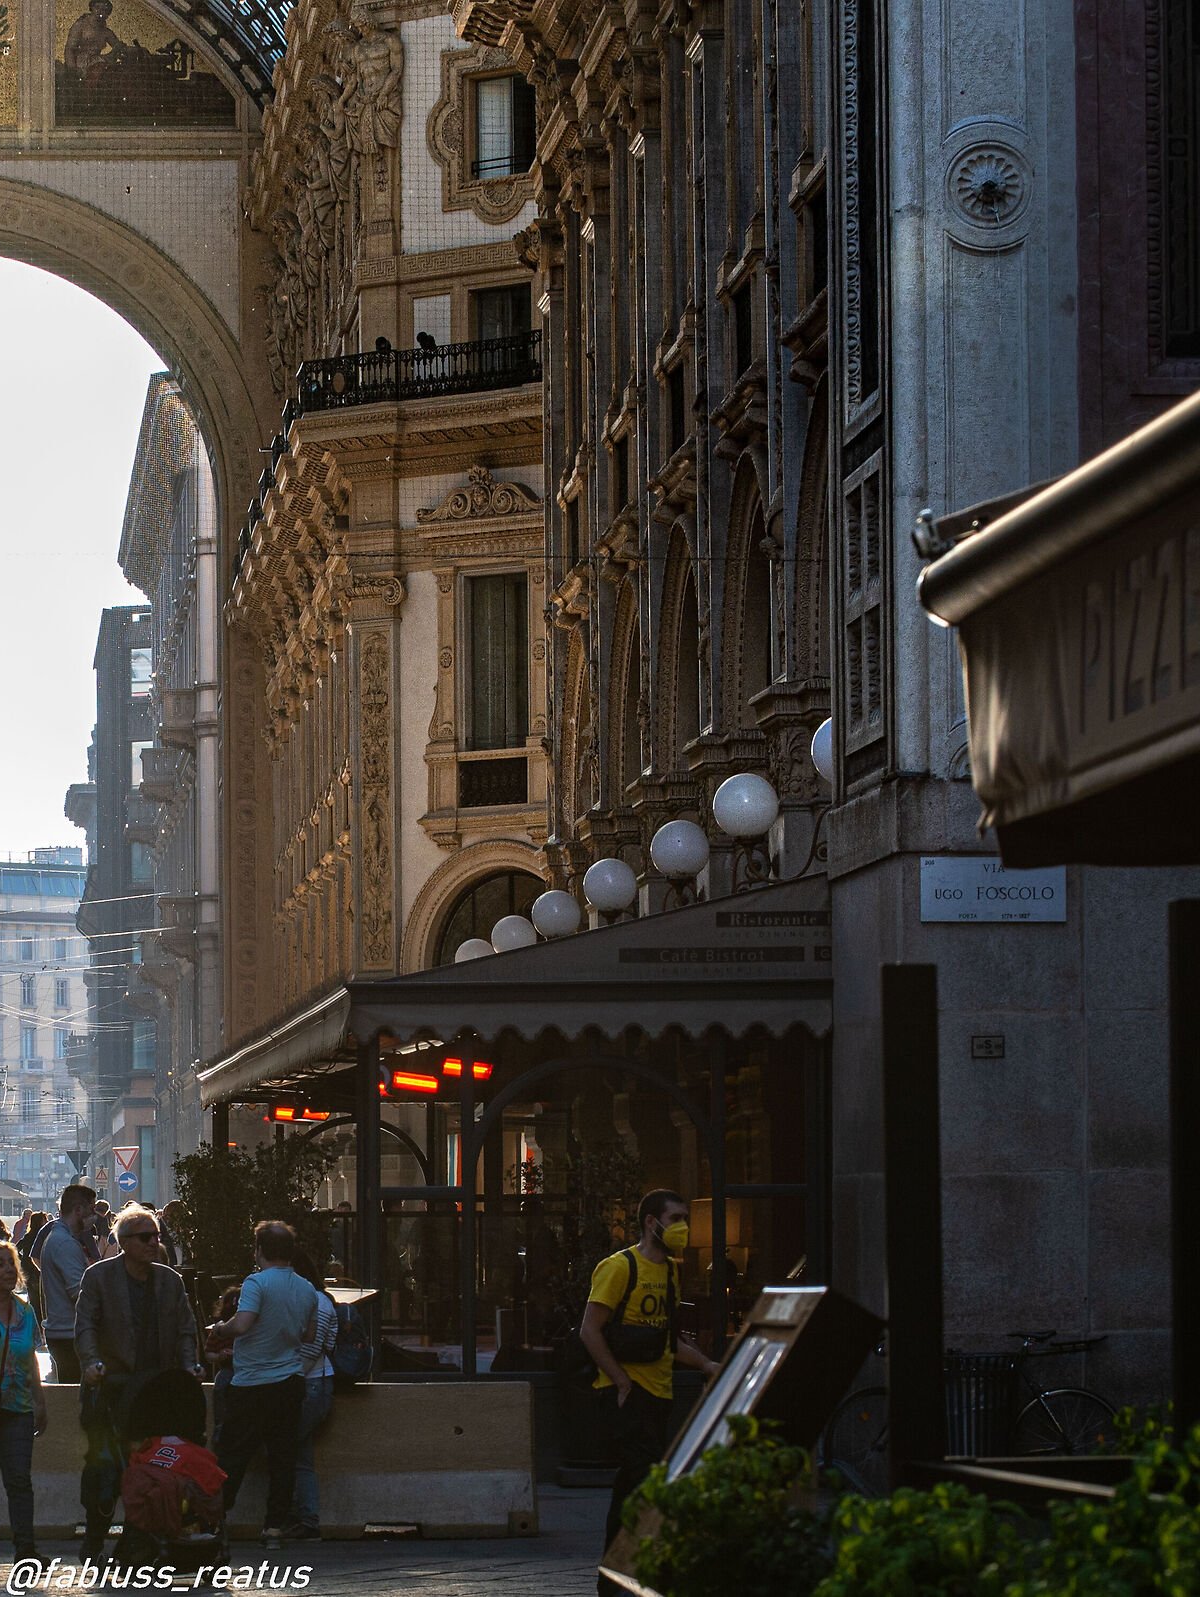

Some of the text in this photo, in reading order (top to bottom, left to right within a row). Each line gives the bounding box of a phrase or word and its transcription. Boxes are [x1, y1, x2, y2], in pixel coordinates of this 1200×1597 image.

[983, 863, 1005, 873] VIA
[935, 887, 1055, 900] UGO FOSCOLO
[729, 912, 817, 926] Ristorante
[705, 948, 766, 962] Bistrot
